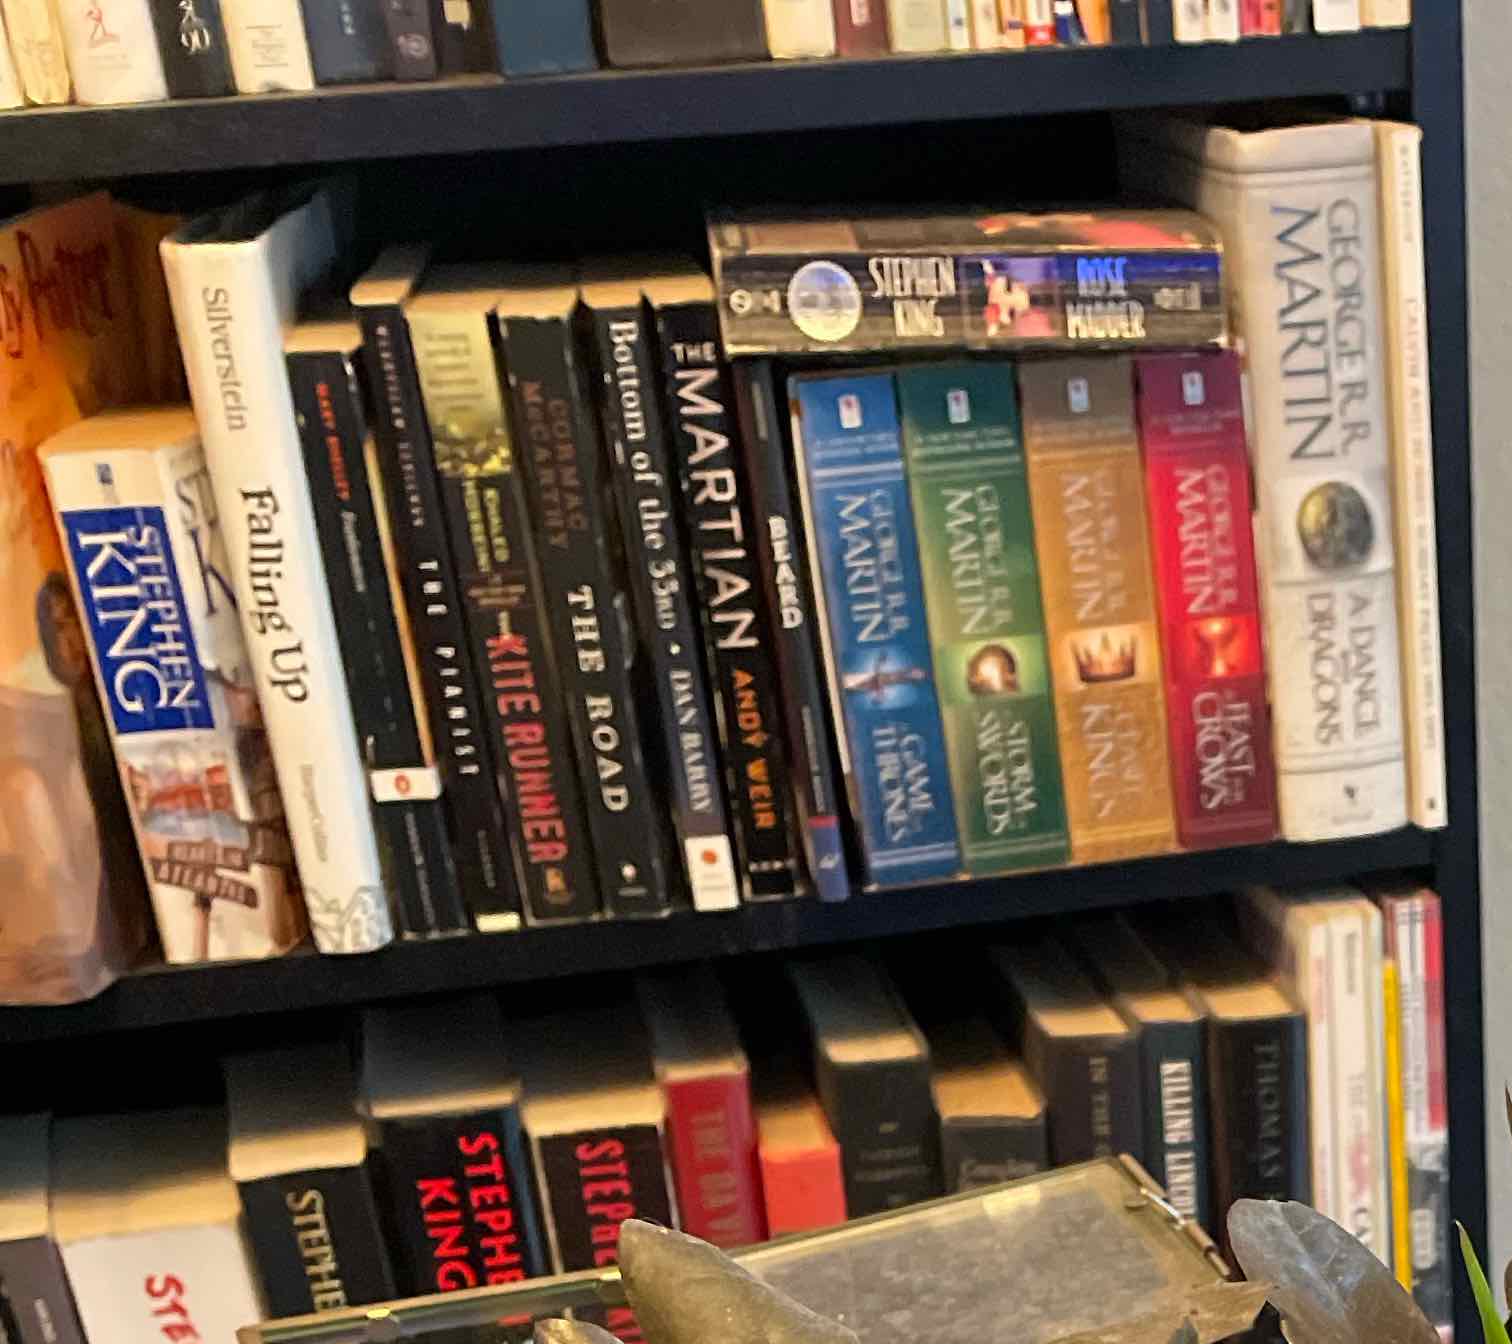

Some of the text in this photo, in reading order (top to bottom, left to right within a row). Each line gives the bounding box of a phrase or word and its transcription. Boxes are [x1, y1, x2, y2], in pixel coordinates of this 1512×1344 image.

[868, 256, 957, 298] STEPHEN
[892, 298, 945, 338] KING
[1075, 256, 1128, 297] ROSE
[1269, 205, 1336, 460] MARTIN
[1327, 197, 1367, 368] GEORGE
[201, 286, 247, 430] Silverstein
[609, 318, 646, 441] Bottom
[630, 450, 665, 487] of
[638, 499, 670, 550] the
[674, 366, 761, 650] MARTIAN
[239, 485, 309, 703] Falling Up
[768, 515, 803, 628] BEARD
[836, 493, 891, 643] MARTIN
[941, 487, 987, 635] MARTIN
[1060, 470, 1104, 622] MARTIN
[1174, 468, 1216, 615] MARTIN
[77, 528, 168, 713] KING
[127, 525, 201, 708] STEPHEN
[486, 634, 542, 707] KITE
[1307, 592, 1344, 746] DRAGONS
[1349, 625, 1381, 737] DANCE
[434, 646, 481, 776] PIANIST
[567, 583, 631, 814] THE ROAD
[669, 669, 714, 815] DAN BARRY
[731, 668, 769, 749] ANDY
[1192, 691, 1230, 810] CROWS
[502, 721, 569, 864] RUNNER
[746, 757, 777, 829] WEIR
[976, 710, 1012, 837] SWORDS
[1006, 720, 1039, 814] STORM
[1161, 1061, 1194, 1144] KILLING
[1253, 1041, 1282, 1178] THOMAS
[286, 1188, 348, 1313] STEPHE
[458, 1130, 532, 1288] STEPHE
